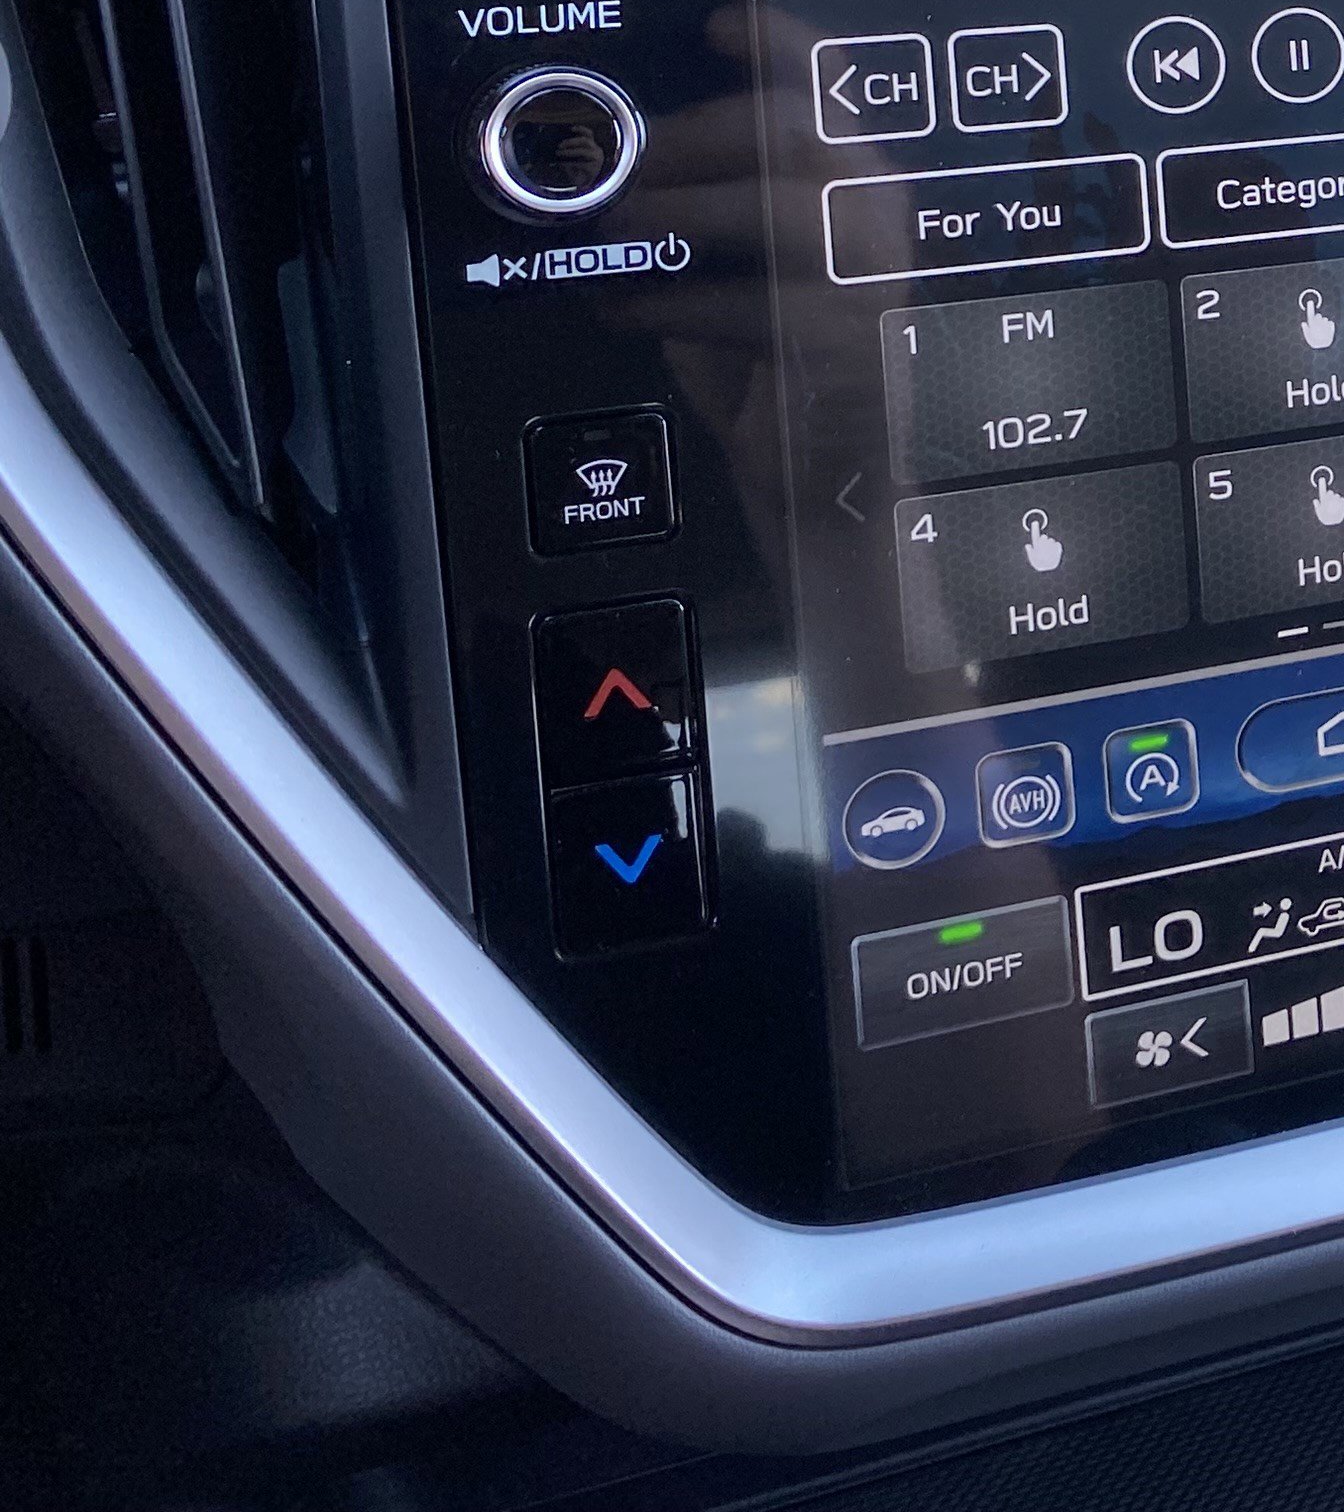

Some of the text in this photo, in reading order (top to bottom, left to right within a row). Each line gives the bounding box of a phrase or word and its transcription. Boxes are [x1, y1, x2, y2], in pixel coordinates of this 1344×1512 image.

[457, 0, 622, 38] VOLUME
[864, 71, 919, 105] CH
[966, 64, 1019, 97] CH
[917, 200, 1062, 240] For You
[1196, 289, 1221, 320] 2
[902, 325, 917, 355] 1
[1002, 309, 1054, 344] FM
[982, 408, 1088, 450] 102.7
[1208, 469, 1233, 500] 5
[563, 496, 646, 525] FRONT
[910, 513, 938, 543] 4
[1009, 594, 1089, 635] Hold
[1108, 909, 1207, 976] LO
[906, 952, 1023, 999] ON/OFF
